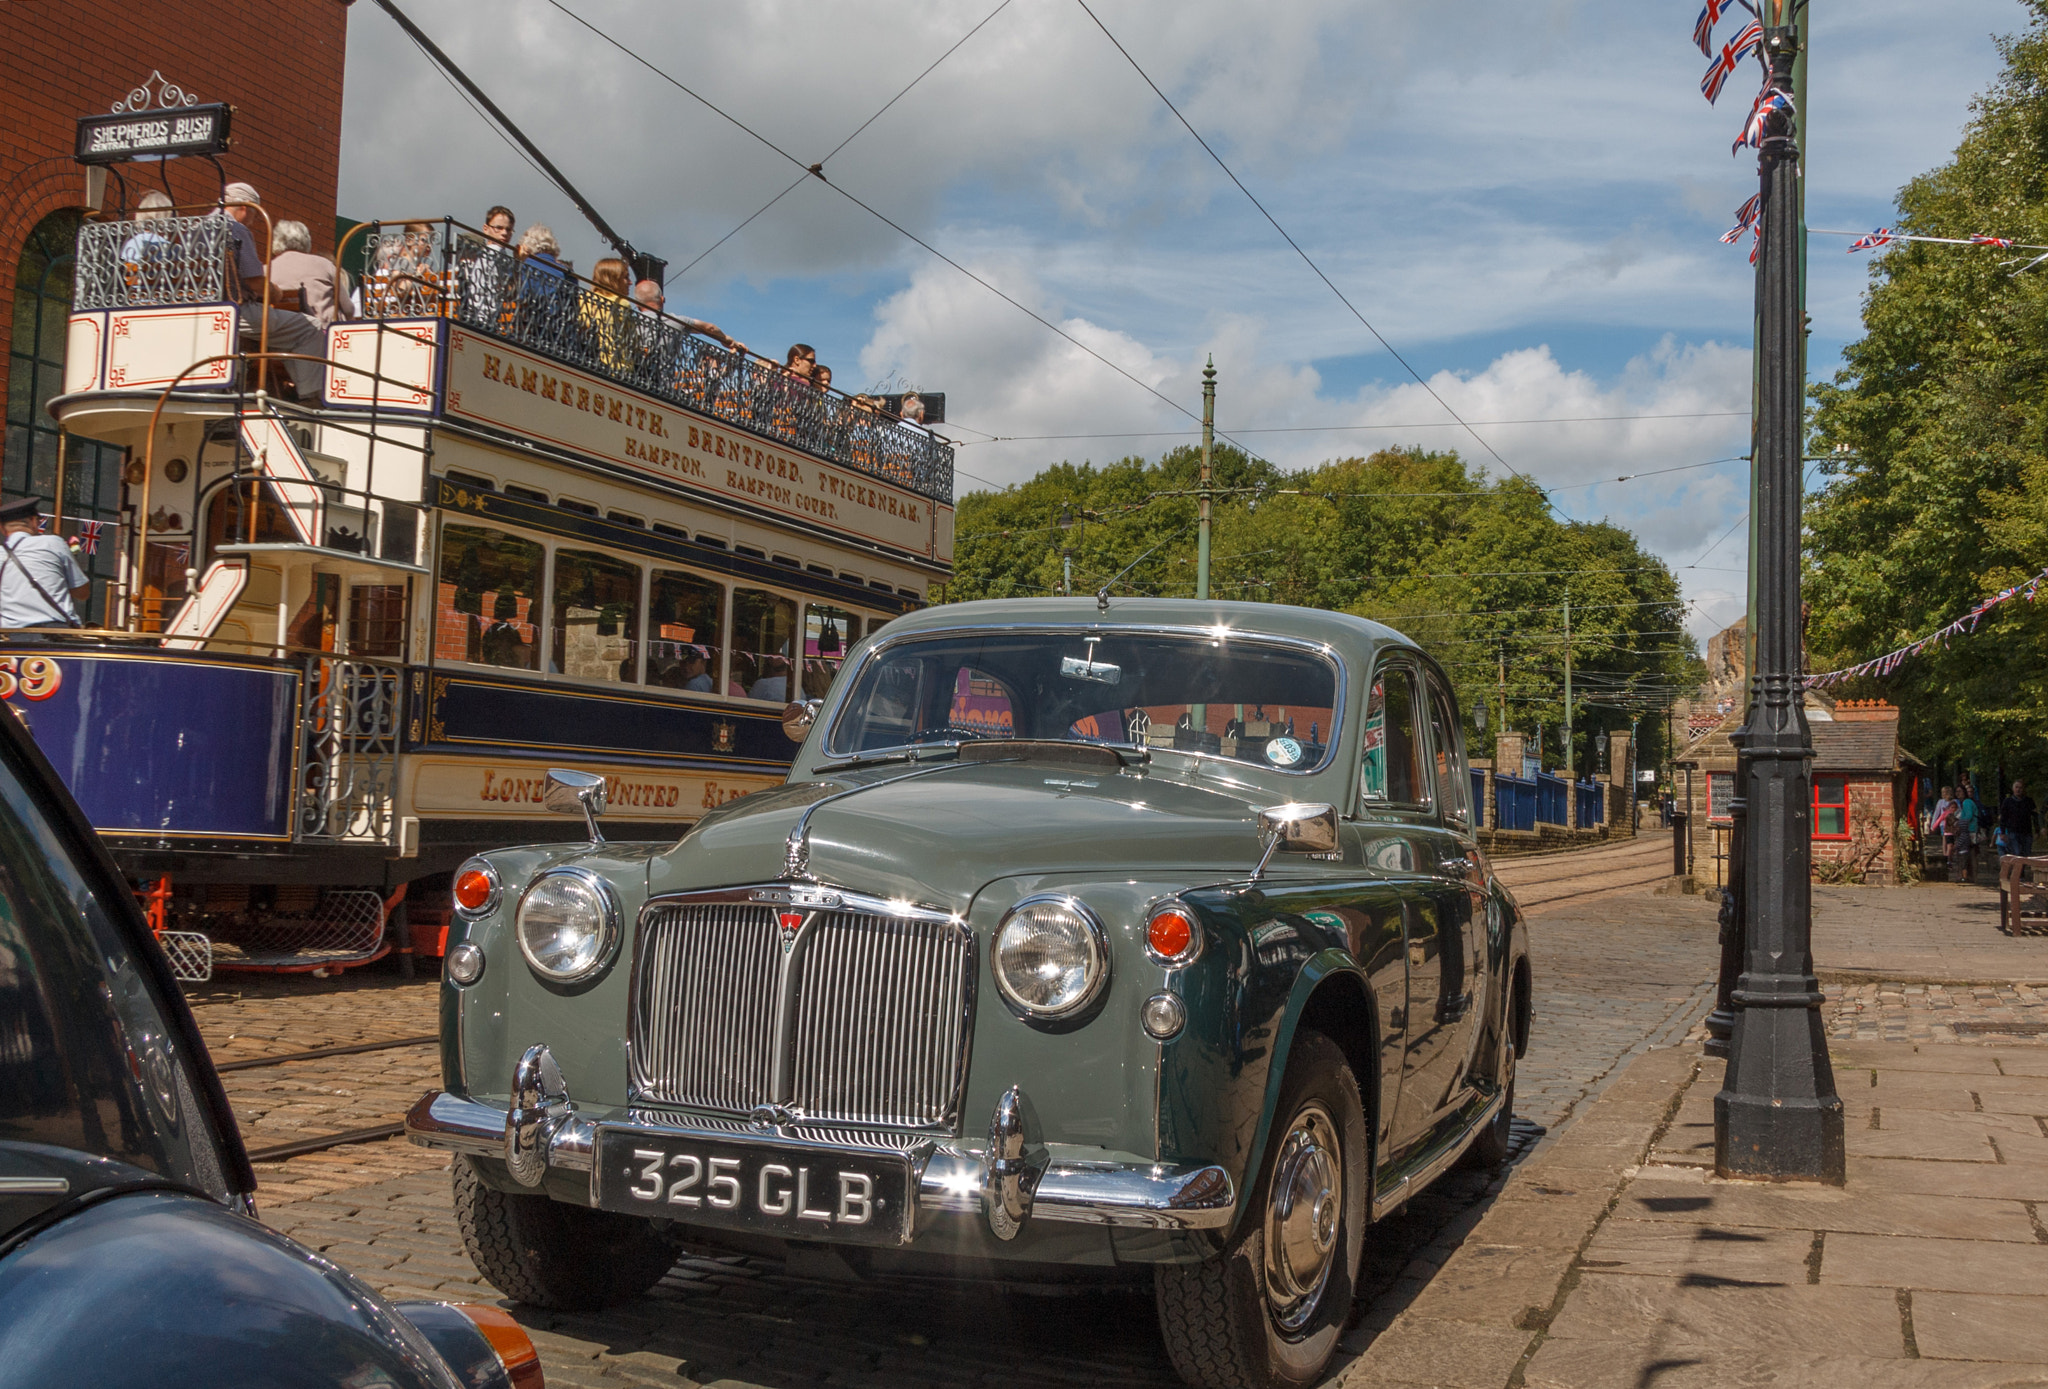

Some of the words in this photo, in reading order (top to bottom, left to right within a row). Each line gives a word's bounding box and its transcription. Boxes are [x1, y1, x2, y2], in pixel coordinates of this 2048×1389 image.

[91, 140, 131, 153] CENTRAL
[133, 135, 168, 148] LONDON
[170, 131, 211, 144] RAILWAY
[93, 120, 169, 144] SHEPHERDS
[176, 116, 213, 134] BUSH
[482, 352, 669, 439] HAMMERSMITH.
[687, 425, 804, 484] BRENTFORD.
[818, 471, 921, 524] TWICKENHAM.
[625, 436, 706, 479] HAMPTON.
[727, 469, 791, 505] HAMPTON
[795, 492, 839, 520] COURT.
[480, 769, 544, 803] LOND
[605, 775, 679, 807] UNITED
[630, 1149, 741, 1209] 325
[758, 1163, 872, 1224] GLB
